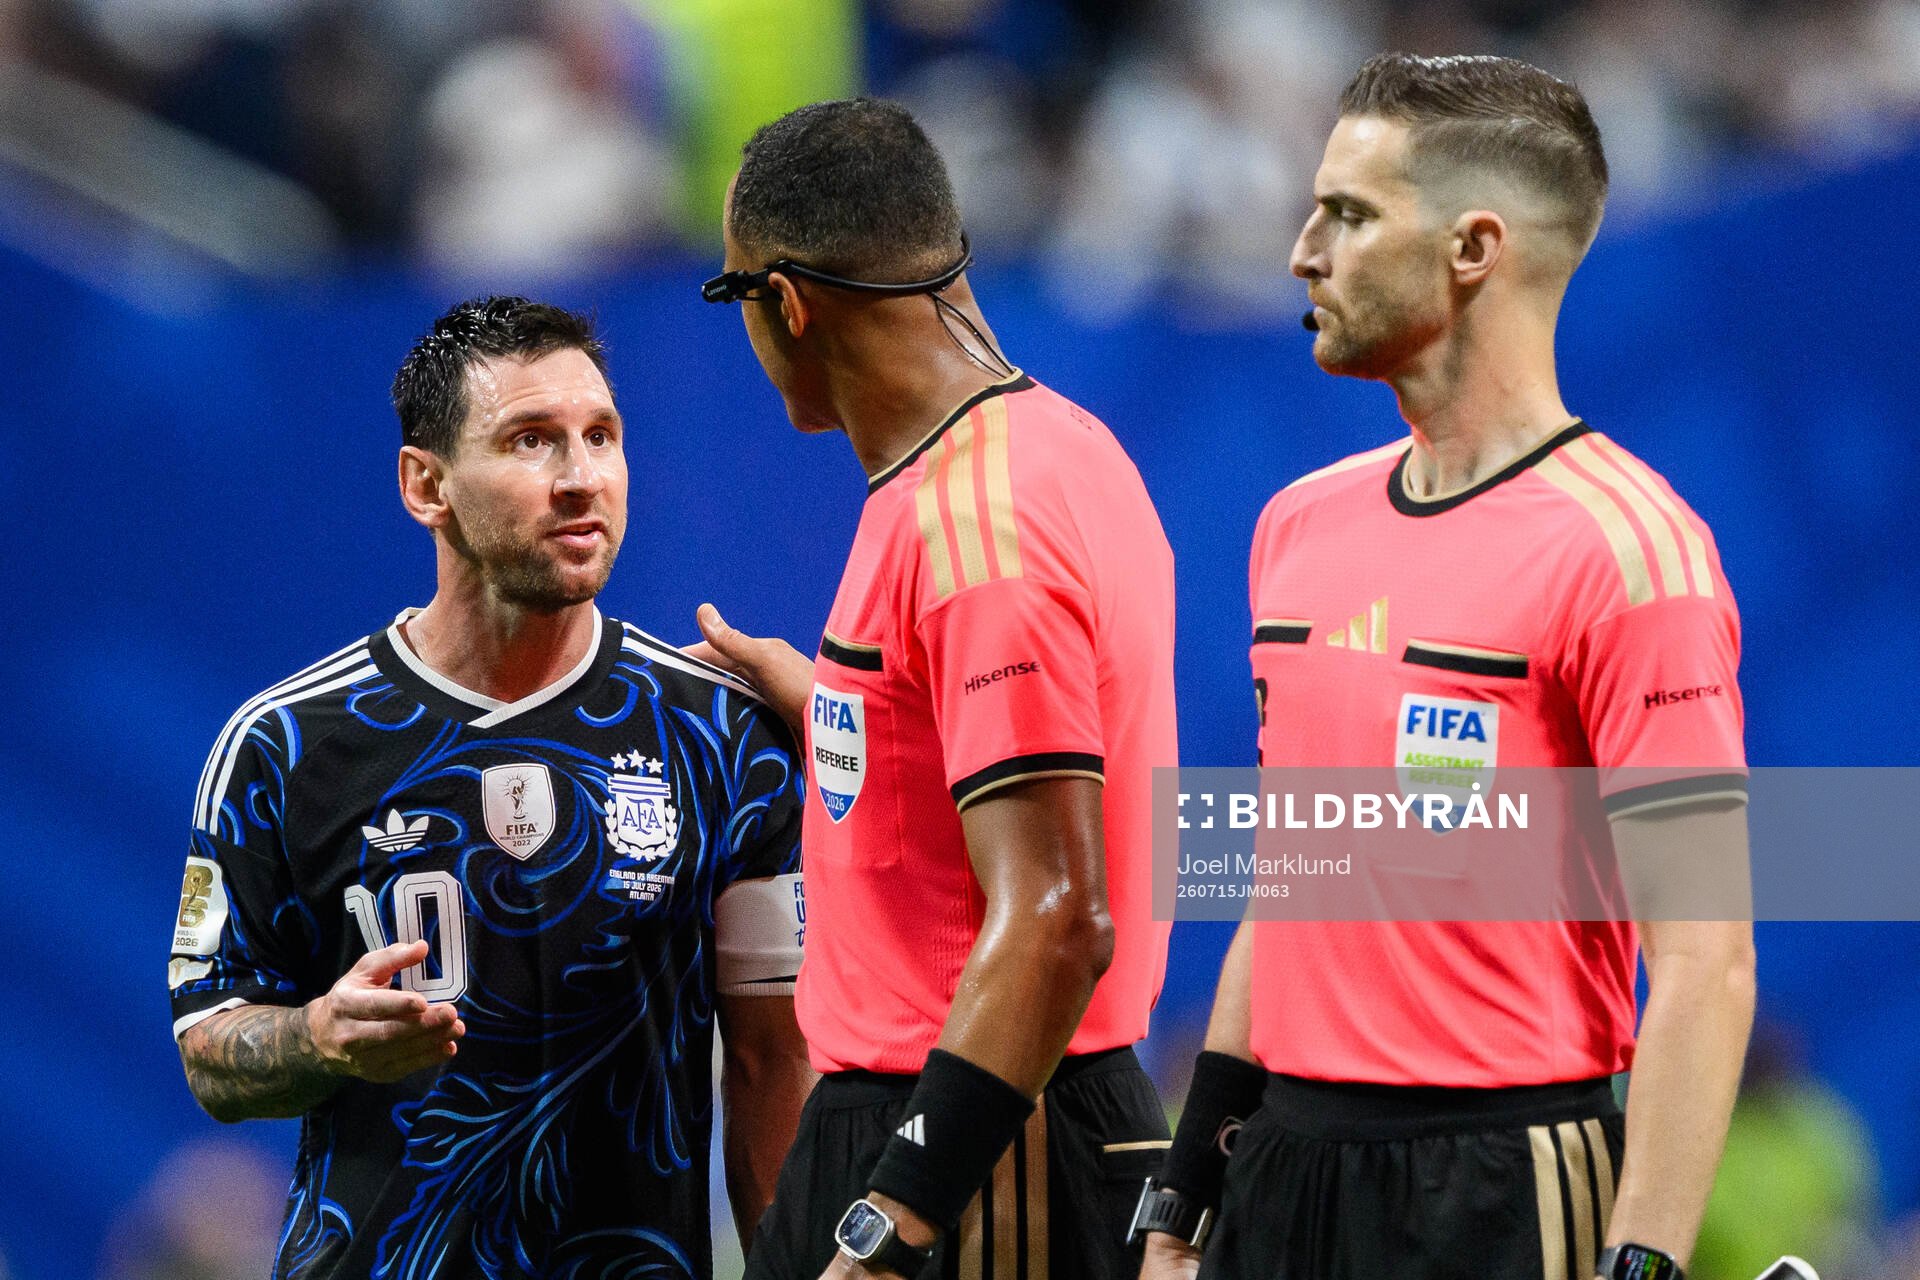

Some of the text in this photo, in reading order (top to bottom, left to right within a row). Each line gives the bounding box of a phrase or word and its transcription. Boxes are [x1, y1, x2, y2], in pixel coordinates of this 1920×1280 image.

[964, 661, 1041, 696] Hisense
[1644, 686, 1722, 709] Hisense
[814, 693, 858, 734] FIFA
[1406, 704, 1487, 743] FIFA
[815, 746, 859, 773] REFEREE
[1404, 751, 1485, 771] ASSISTANT
[826, 793, 846, 812] 2026
[506, 823, 537, 835] FIFA
[609, 869, 675, 884] ENGLAND VS ARGENTINA
[623, 881, 662, 892] 15 JULY 2026
[629, 891, 655, 901] ATLANTA
[175, 936, 199, 947] 2026
[344, 871, 468, 1003] 10
